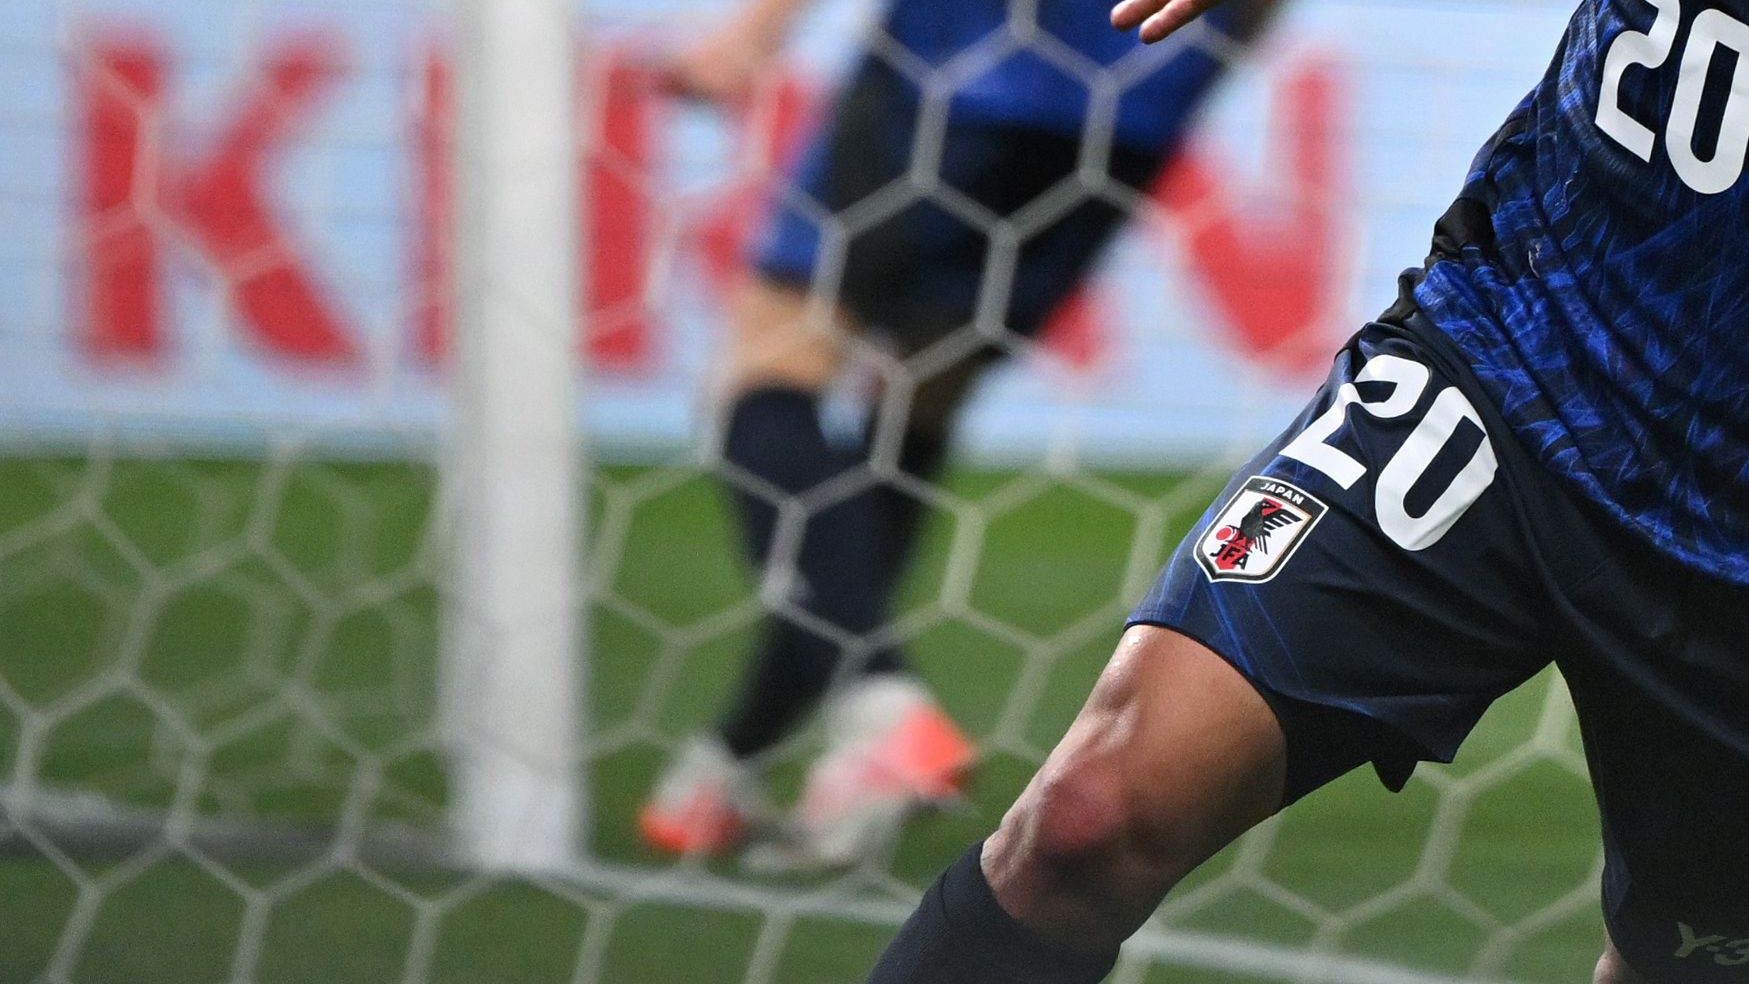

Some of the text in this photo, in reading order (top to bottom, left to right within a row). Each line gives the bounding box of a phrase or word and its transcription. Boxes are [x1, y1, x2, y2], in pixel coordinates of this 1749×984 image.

[1279, 354, 1499, 552] 20
[1260, 482, 1304, 505] JAPAN
[1209, 543, 1250, 570] JFA
